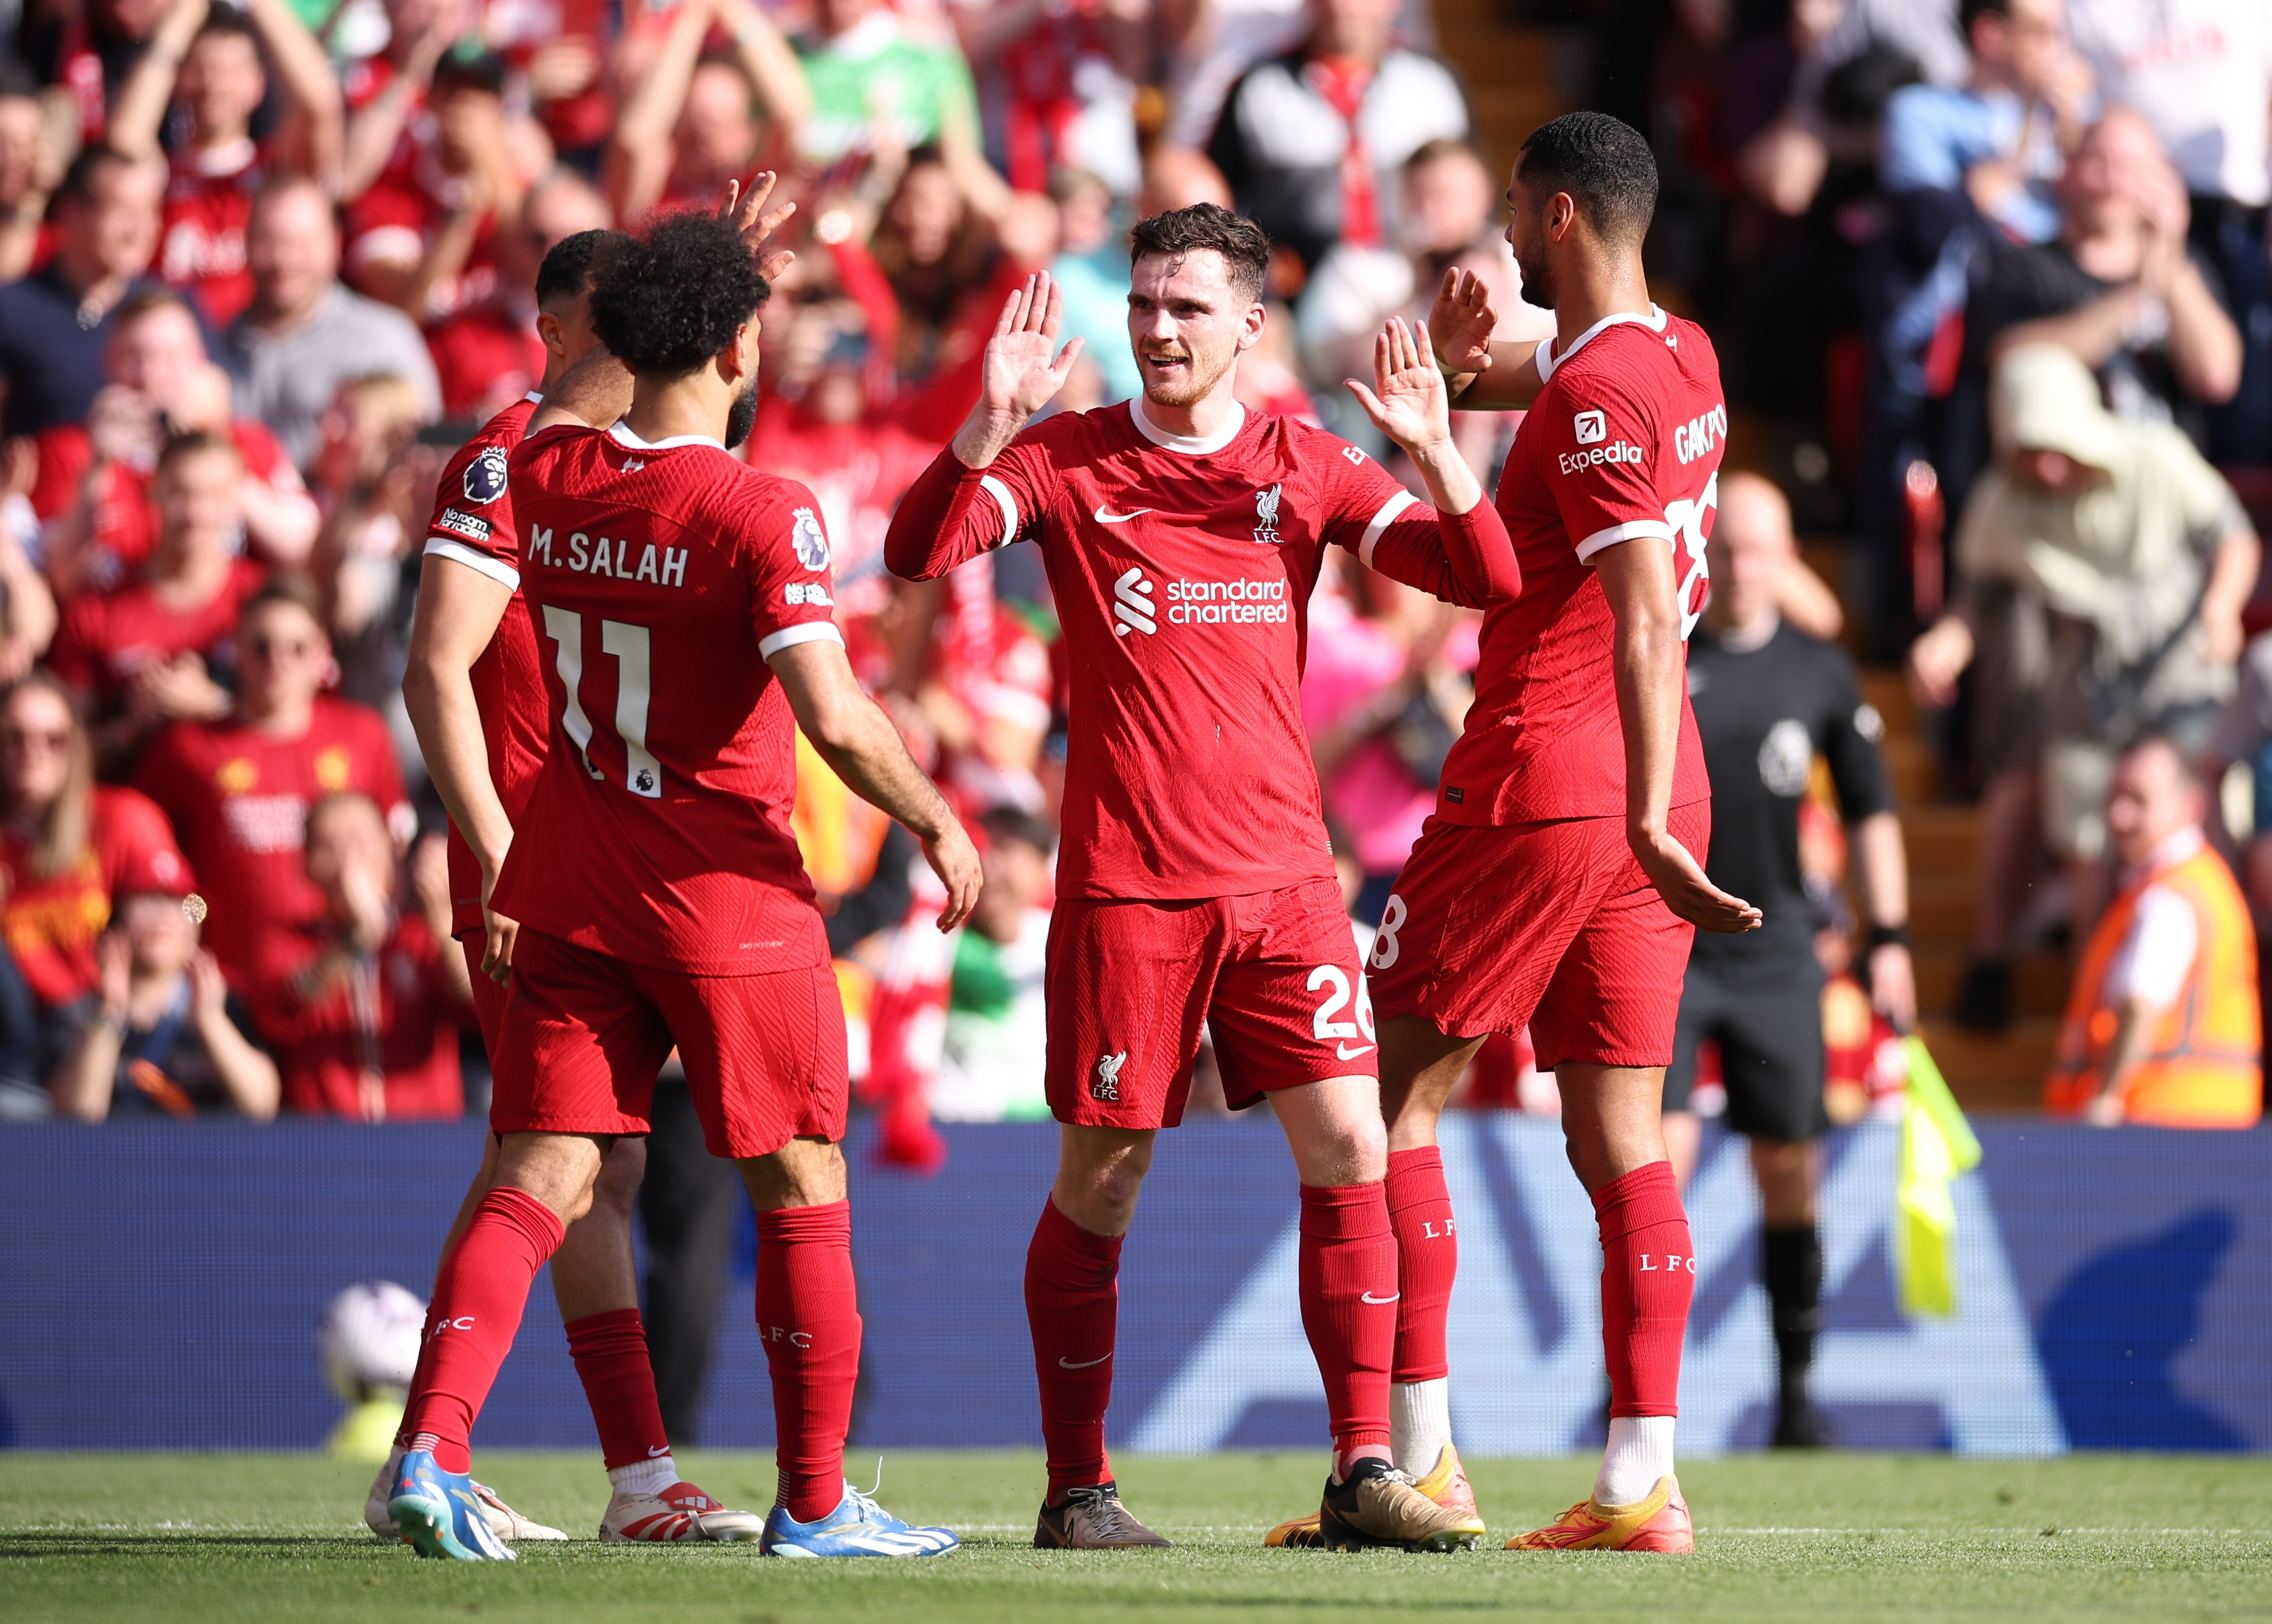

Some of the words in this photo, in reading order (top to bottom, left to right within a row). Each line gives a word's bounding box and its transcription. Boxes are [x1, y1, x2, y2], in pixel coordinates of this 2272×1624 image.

[1674, 403, 1727, 465] GAKPO
[1558, 440, 1643, 475] Expedia
[444, 507, 458, 520] No
[457, 513, 487, 532] room
[451, 521, 489, 542] racism
[1253, 532, 1284, 543] L.F.C.
[528, 523, 688, 587] M.SALAH
[785, 583, 805, 595] No
[1167, 577, 1285, 601] standard
[1168, 600, 1287, 624] chartered
[542, 603, 662, 798] 11
[1093, 1087, 1119, 1101] L.F.C.
